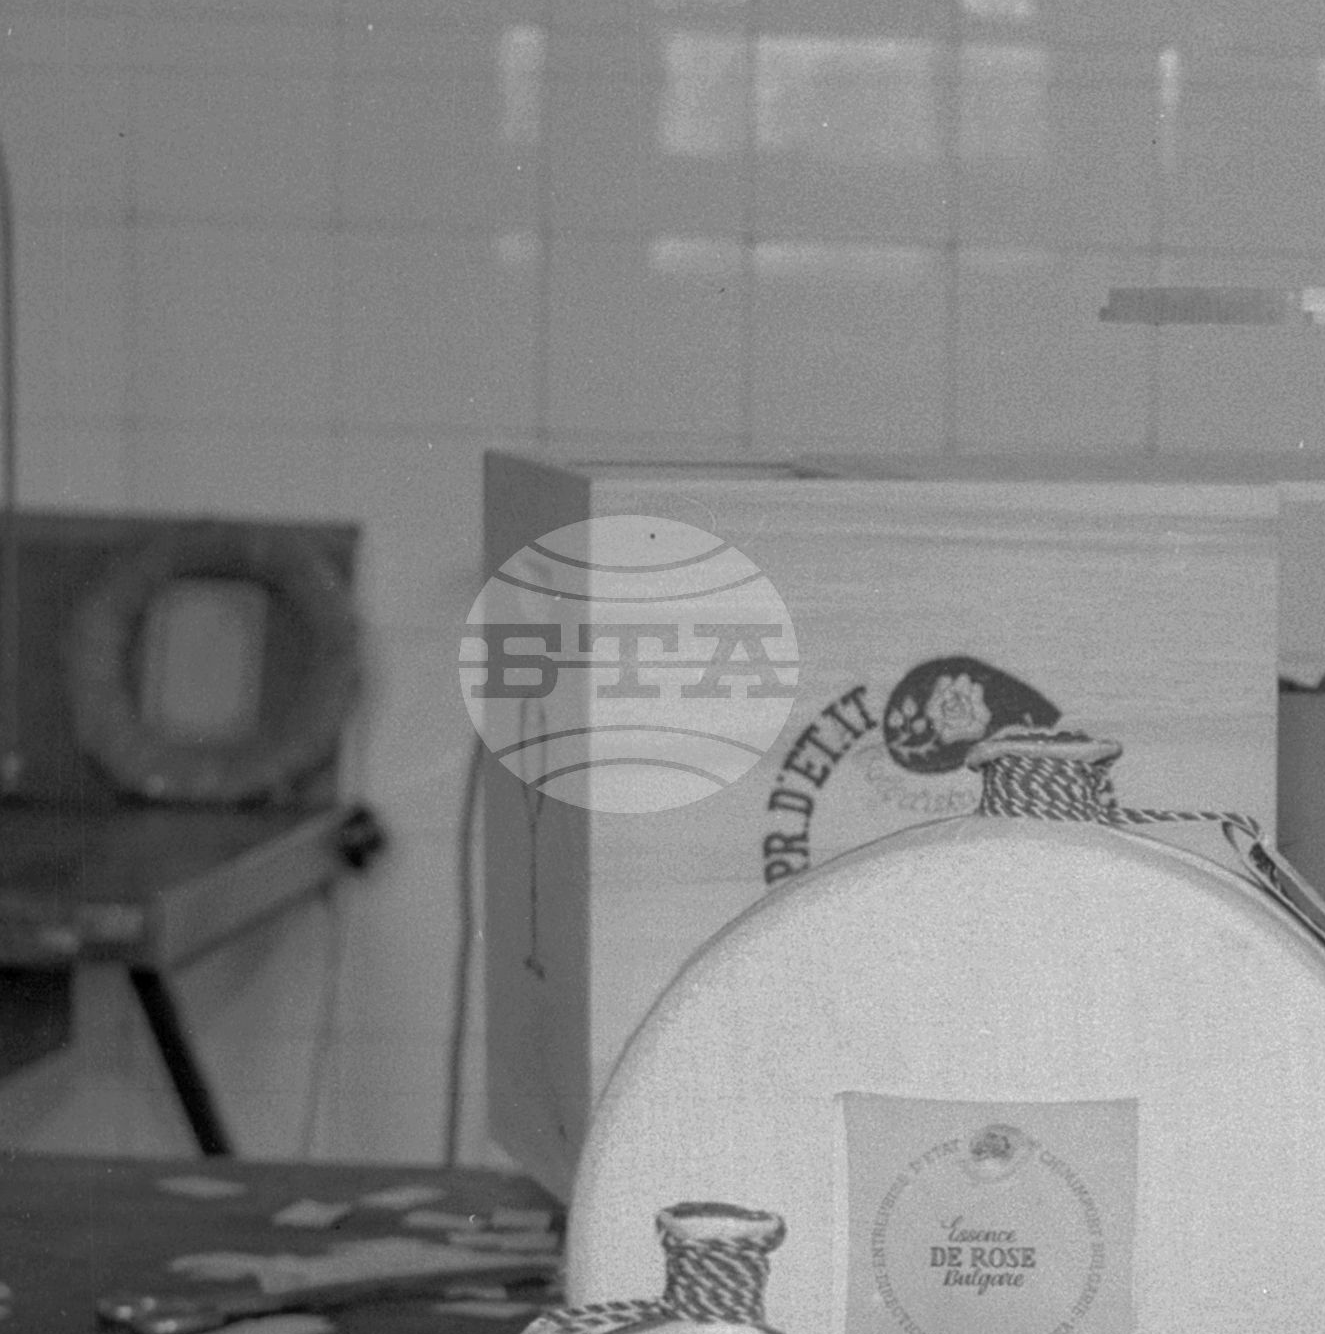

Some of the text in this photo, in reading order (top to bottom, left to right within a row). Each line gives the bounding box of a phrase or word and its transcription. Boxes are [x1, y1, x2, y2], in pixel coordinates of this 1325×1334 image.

[940, 1215, 1018, 1244] Essence
[930, 1246, 1037, 1268] DE ROSE
[942, 1268, 1025, 1297] Bulgare
